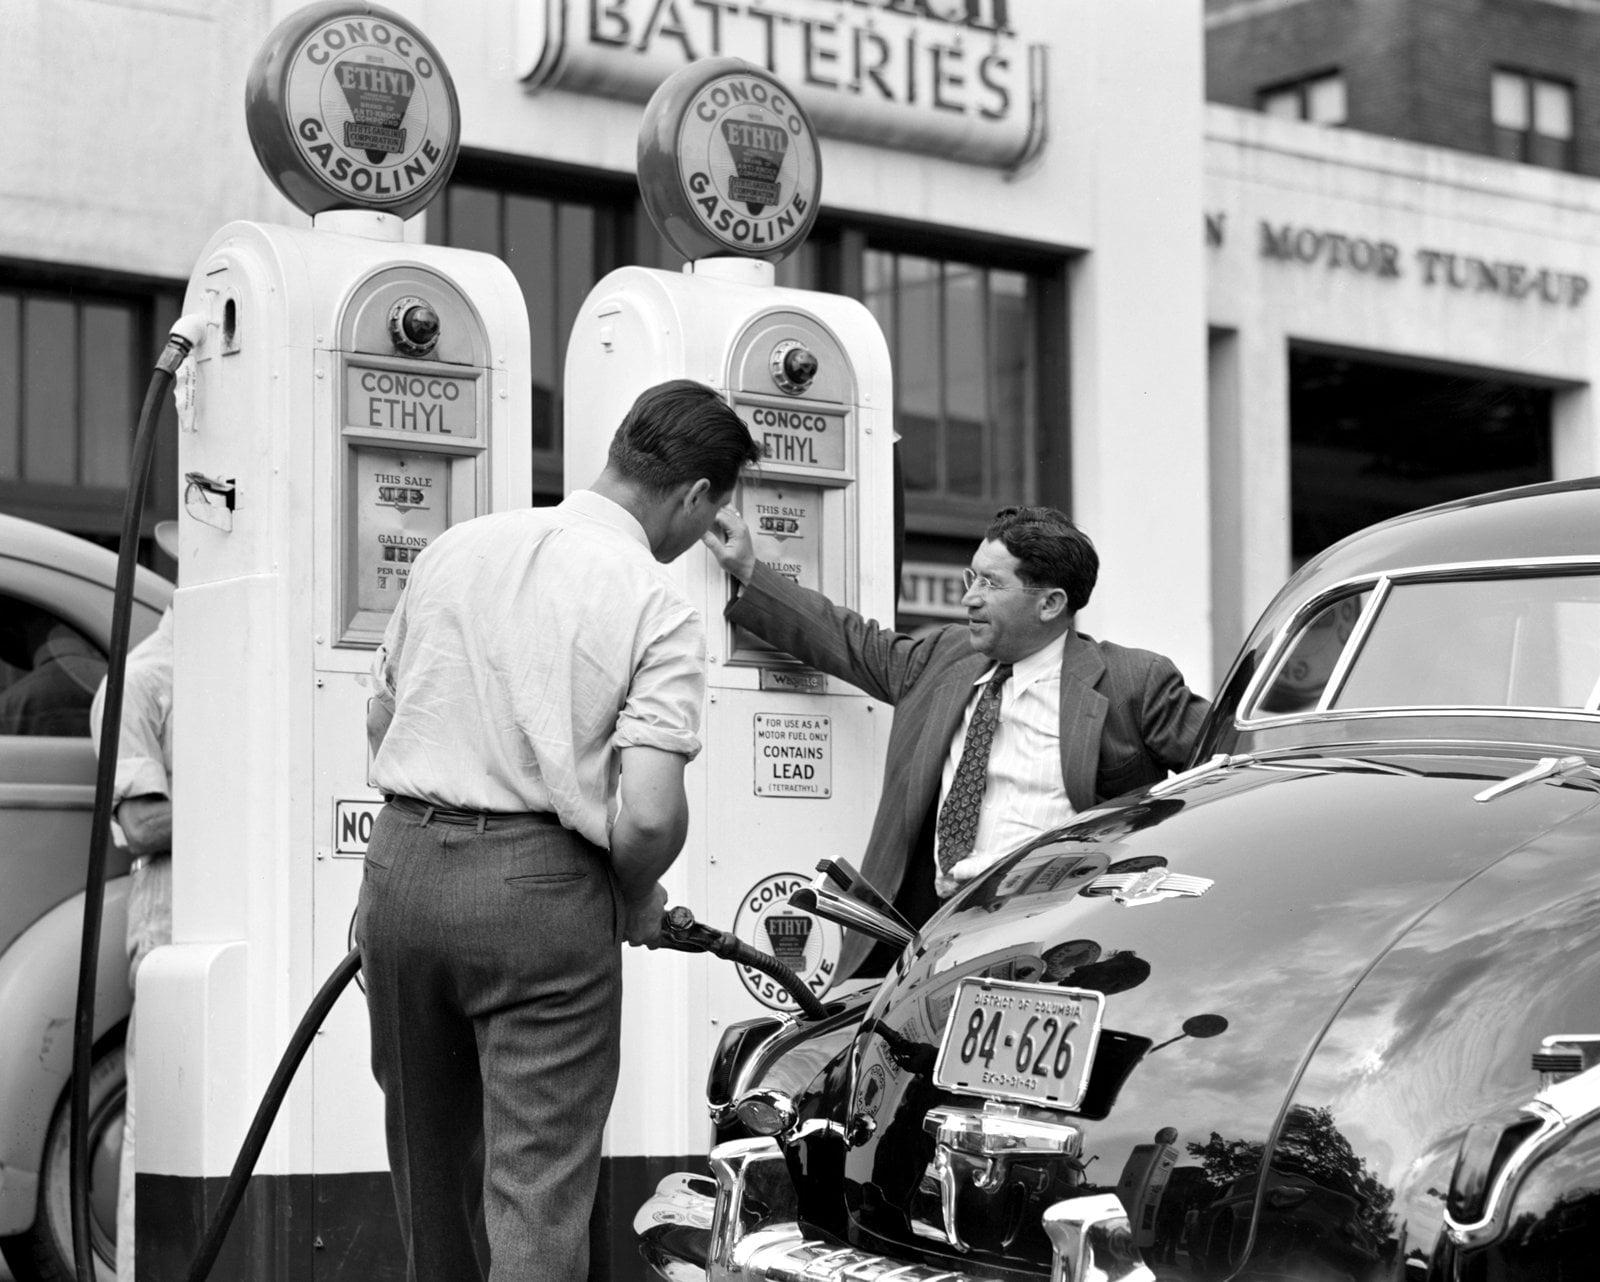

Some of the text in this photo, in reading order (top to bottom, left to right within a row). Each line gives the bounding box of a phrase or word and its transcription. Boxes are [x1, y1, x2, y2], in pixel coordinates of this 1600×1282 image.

[306, 22, 433, 79] CONOCO
[589, 0, 1010, 120] BATTERIES
[341, 66, 412, 97] ETHYL
[696, 82, 801, 136] CONOCO
[727, 123, 787, 153] ETHYL
[299, 118, 441, 194] GASOLINE
[689, 172, 807, 243] GASOLINE
[1258, 219, 1401, 279] MOTOR
[1416, 248, 1590, 308] TUNE-UP
[361, 372, 459, 401] CONOCO
[369, 397, 452, 434] ETHYL
[753, 409, 827, 433] CONOCO
[763, 432, 818, 464] ETHYL
[374, 473, 432, 488] THIS SALE
[756, 504, 806, 518] THIS SALE
[378, 534, 428, 547] GALLONS
[377, 567, 394, 576] PER
[758, 730, 829, 742] MOTOR FUEL ONLY
[766, 718, 821, 729] FOR USE AS A
[763, 745, 824, 760] CONTAINS
[773, 763, 815, 780] LEAD
[343, 811, 375, 844] NO
[769, 919, 809, 936] ETHYL
[974, 993, 1082, 1018] DISTRICT OF COLUMBIA
